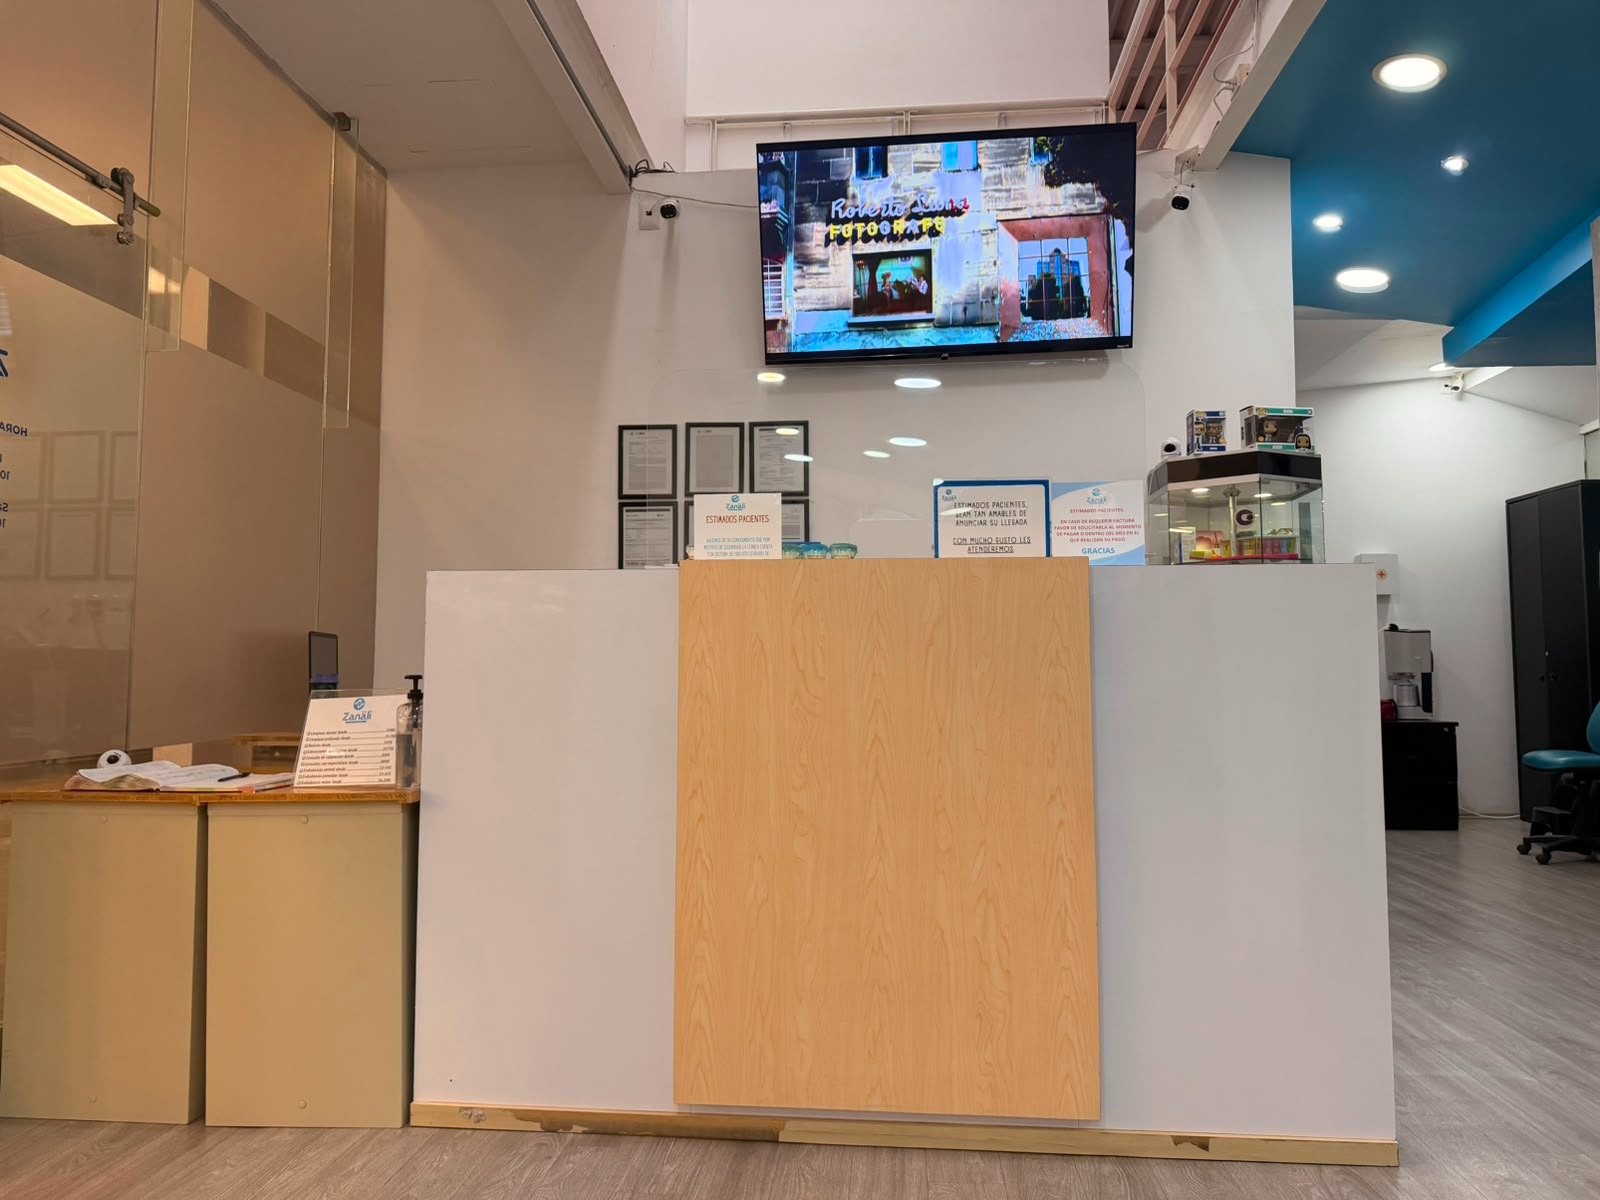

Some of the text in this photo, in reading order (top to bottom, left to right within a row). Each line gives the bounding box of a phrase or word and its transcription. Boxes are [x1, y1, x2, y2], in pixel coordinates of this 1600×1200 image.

[706, 514, 770, 524] ESTIMADOS PACIENTES
[955, 519, 987, 527] ANUNCIAR
